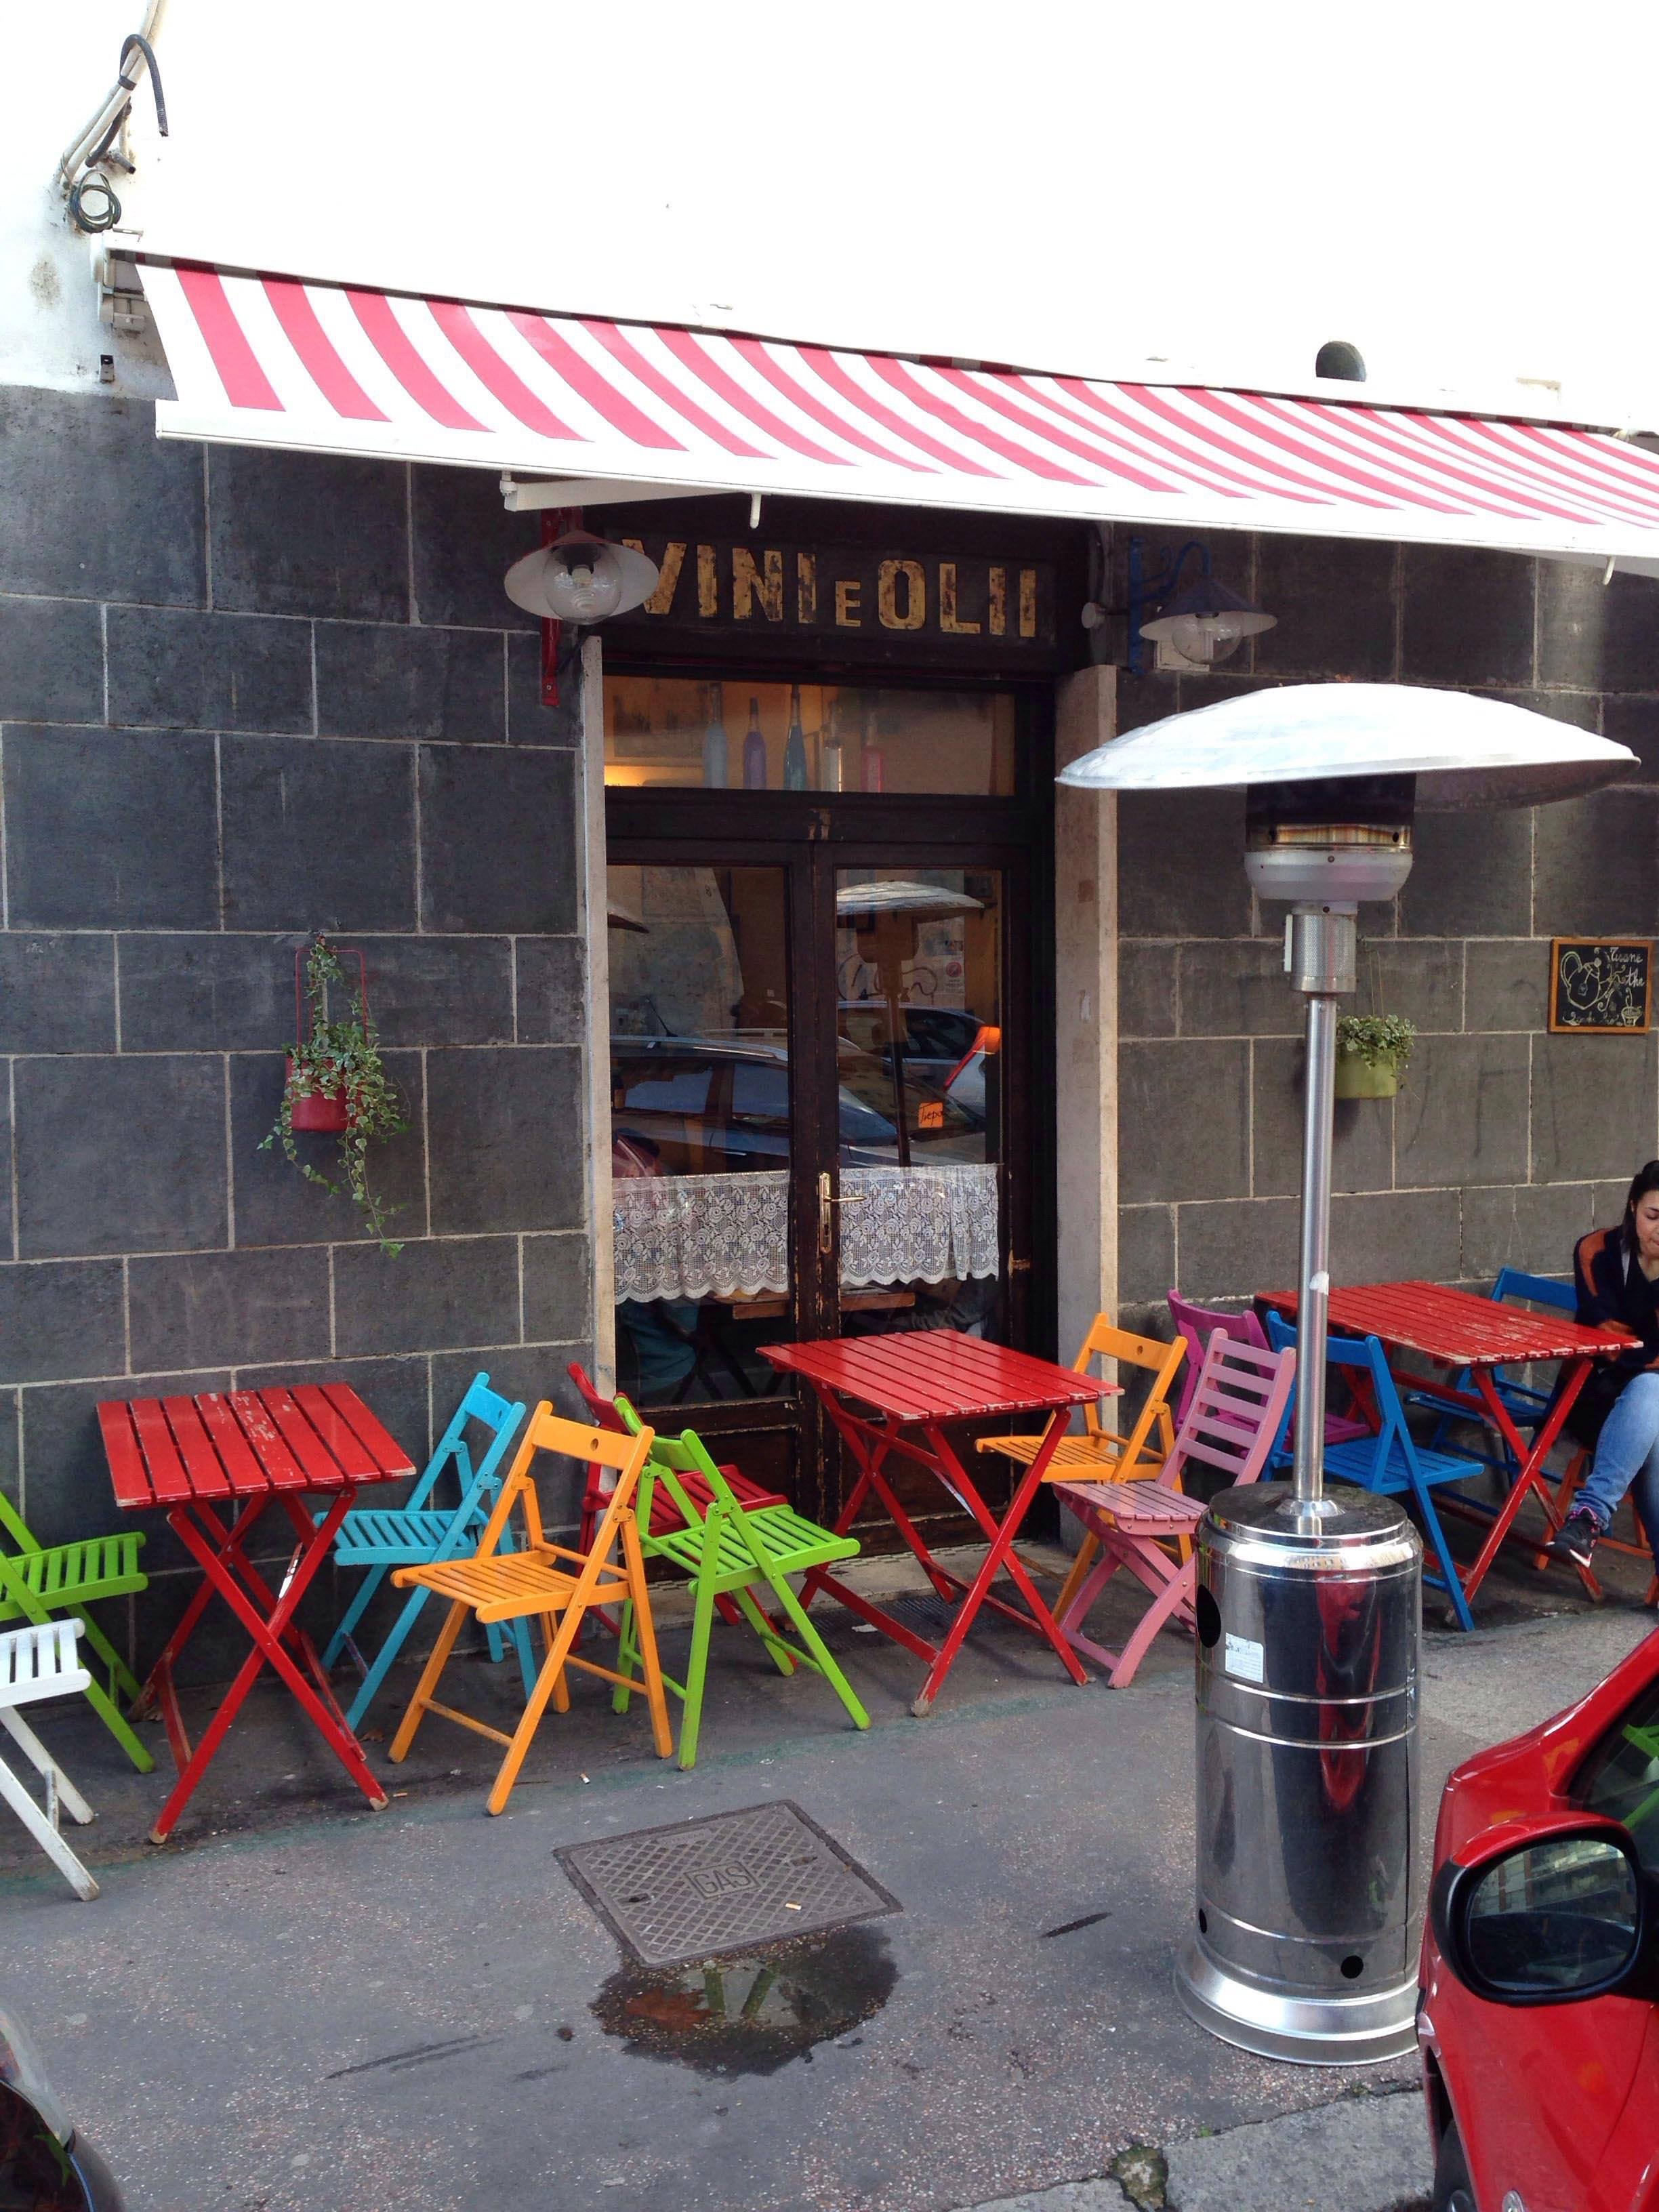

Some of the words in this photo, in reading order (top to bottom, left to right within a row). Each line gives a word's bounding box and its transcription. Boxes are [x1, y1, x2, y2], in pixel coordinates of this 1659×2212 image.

[621, 539, 817, 624] VINI
[878, 559, 1037, 638] OLII
[694, 1866, 751, 1893] GAS
